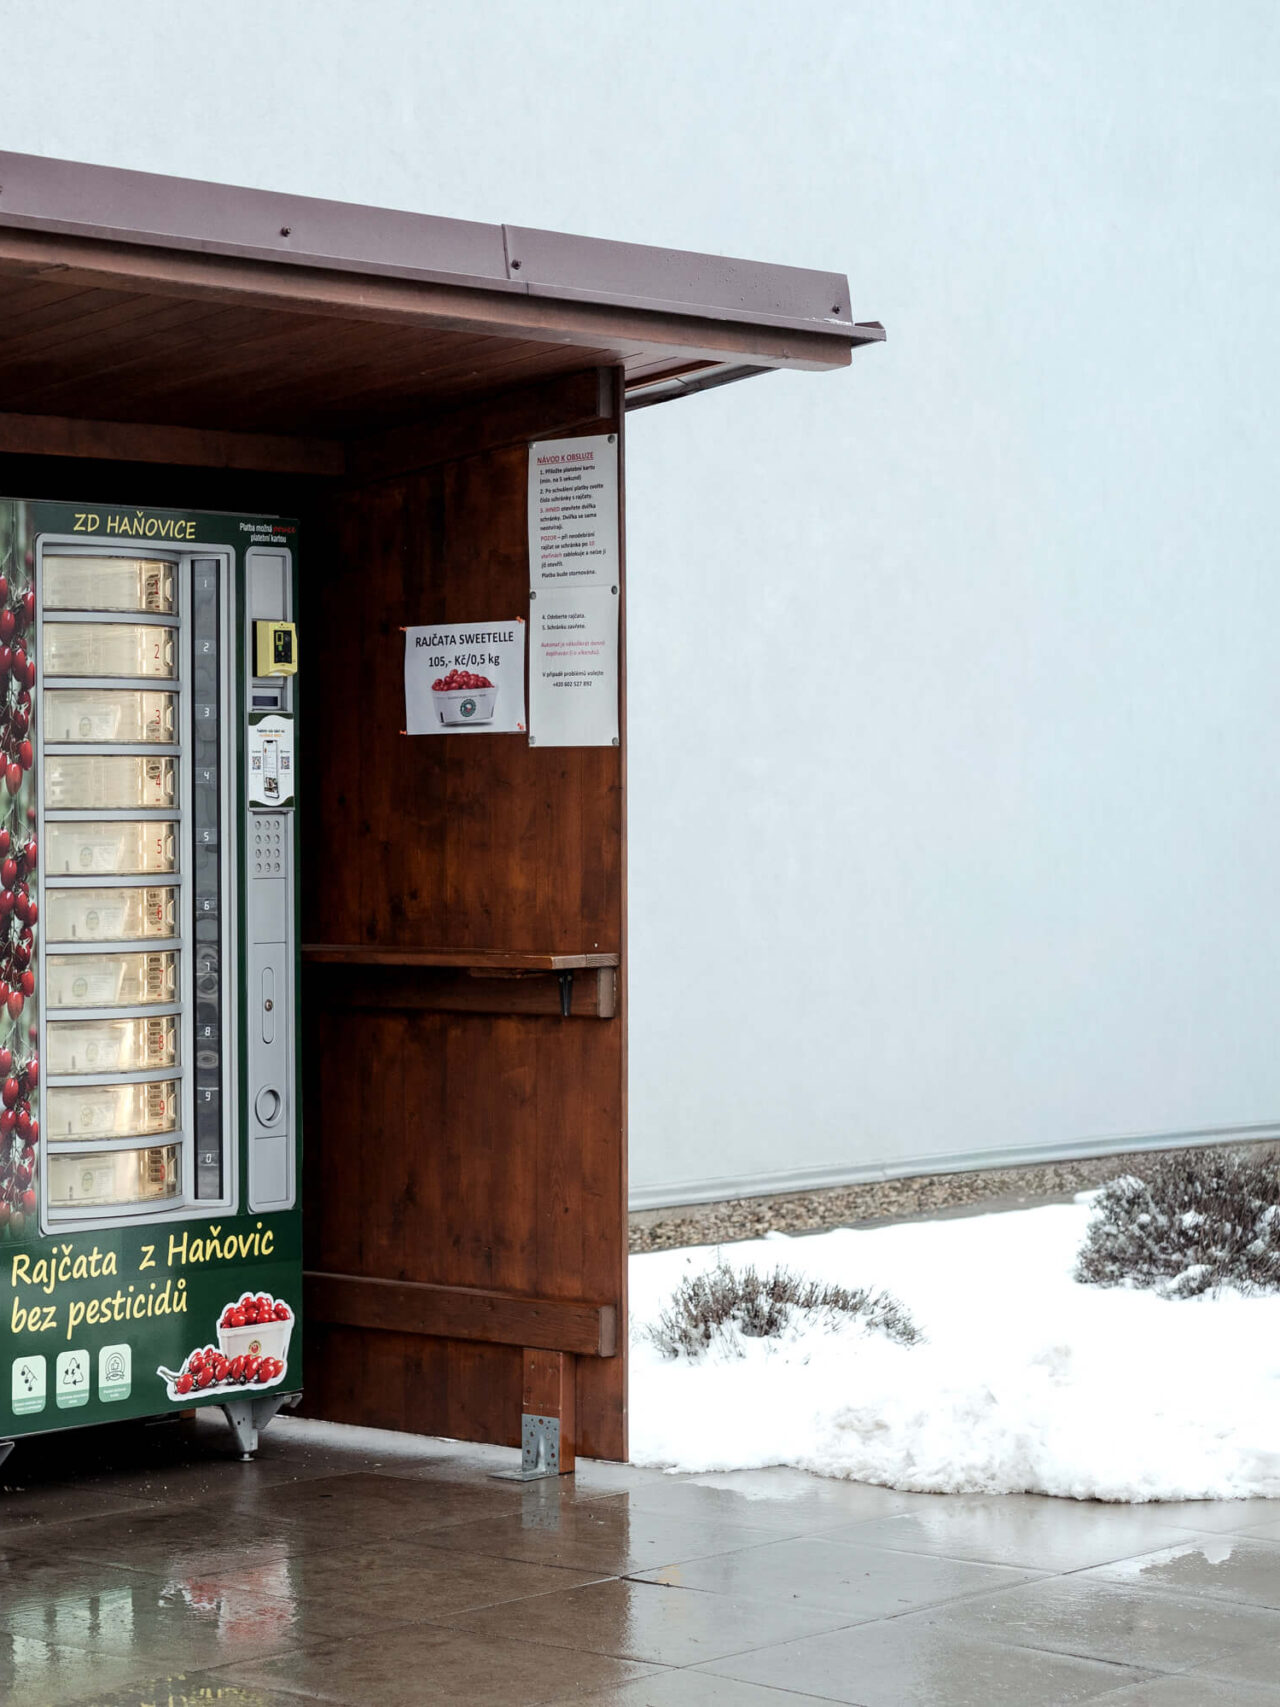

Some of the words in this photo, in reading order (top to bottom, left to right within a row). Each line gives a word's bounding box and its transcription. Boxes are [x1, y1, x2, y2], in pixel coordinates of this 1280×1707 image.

[73, 512, 100, 531] ZD
[107, 510, 195, 539] HAŇOVICE
[239, 522, 256, 532] Platba
[255, 524, 273, 533] možná
[250, 532, 271, 543] platební
[270, 534, 287, 543] kartou
[415, 633, 457, 648] RAJČATA
[459, 631, 514, 645] SWEETELLE
[154, 643, 160, 659] 2
[203, 642, 210, 653] 2
[428, 656, 452, 668] 105,-
[488, 653, 500, 666] kg
[204, 707, 210, 718] 3
[203, 771, 210, 780] 4
[203, 831, 210, 842] 5
[156, 837, 163, 855] 5
[204, 1026, 210, 1037] 8
[205, 1091, 211, 1101] 9
[10, 1245, 118, 1294] Rajčata
[138, 1245, 156, 1271] z
[167, 1222, 274, 1266] Haňovic
[11, 1297, 57, 1333] bez
[66, 1278, 187, 1340] pesticidů
